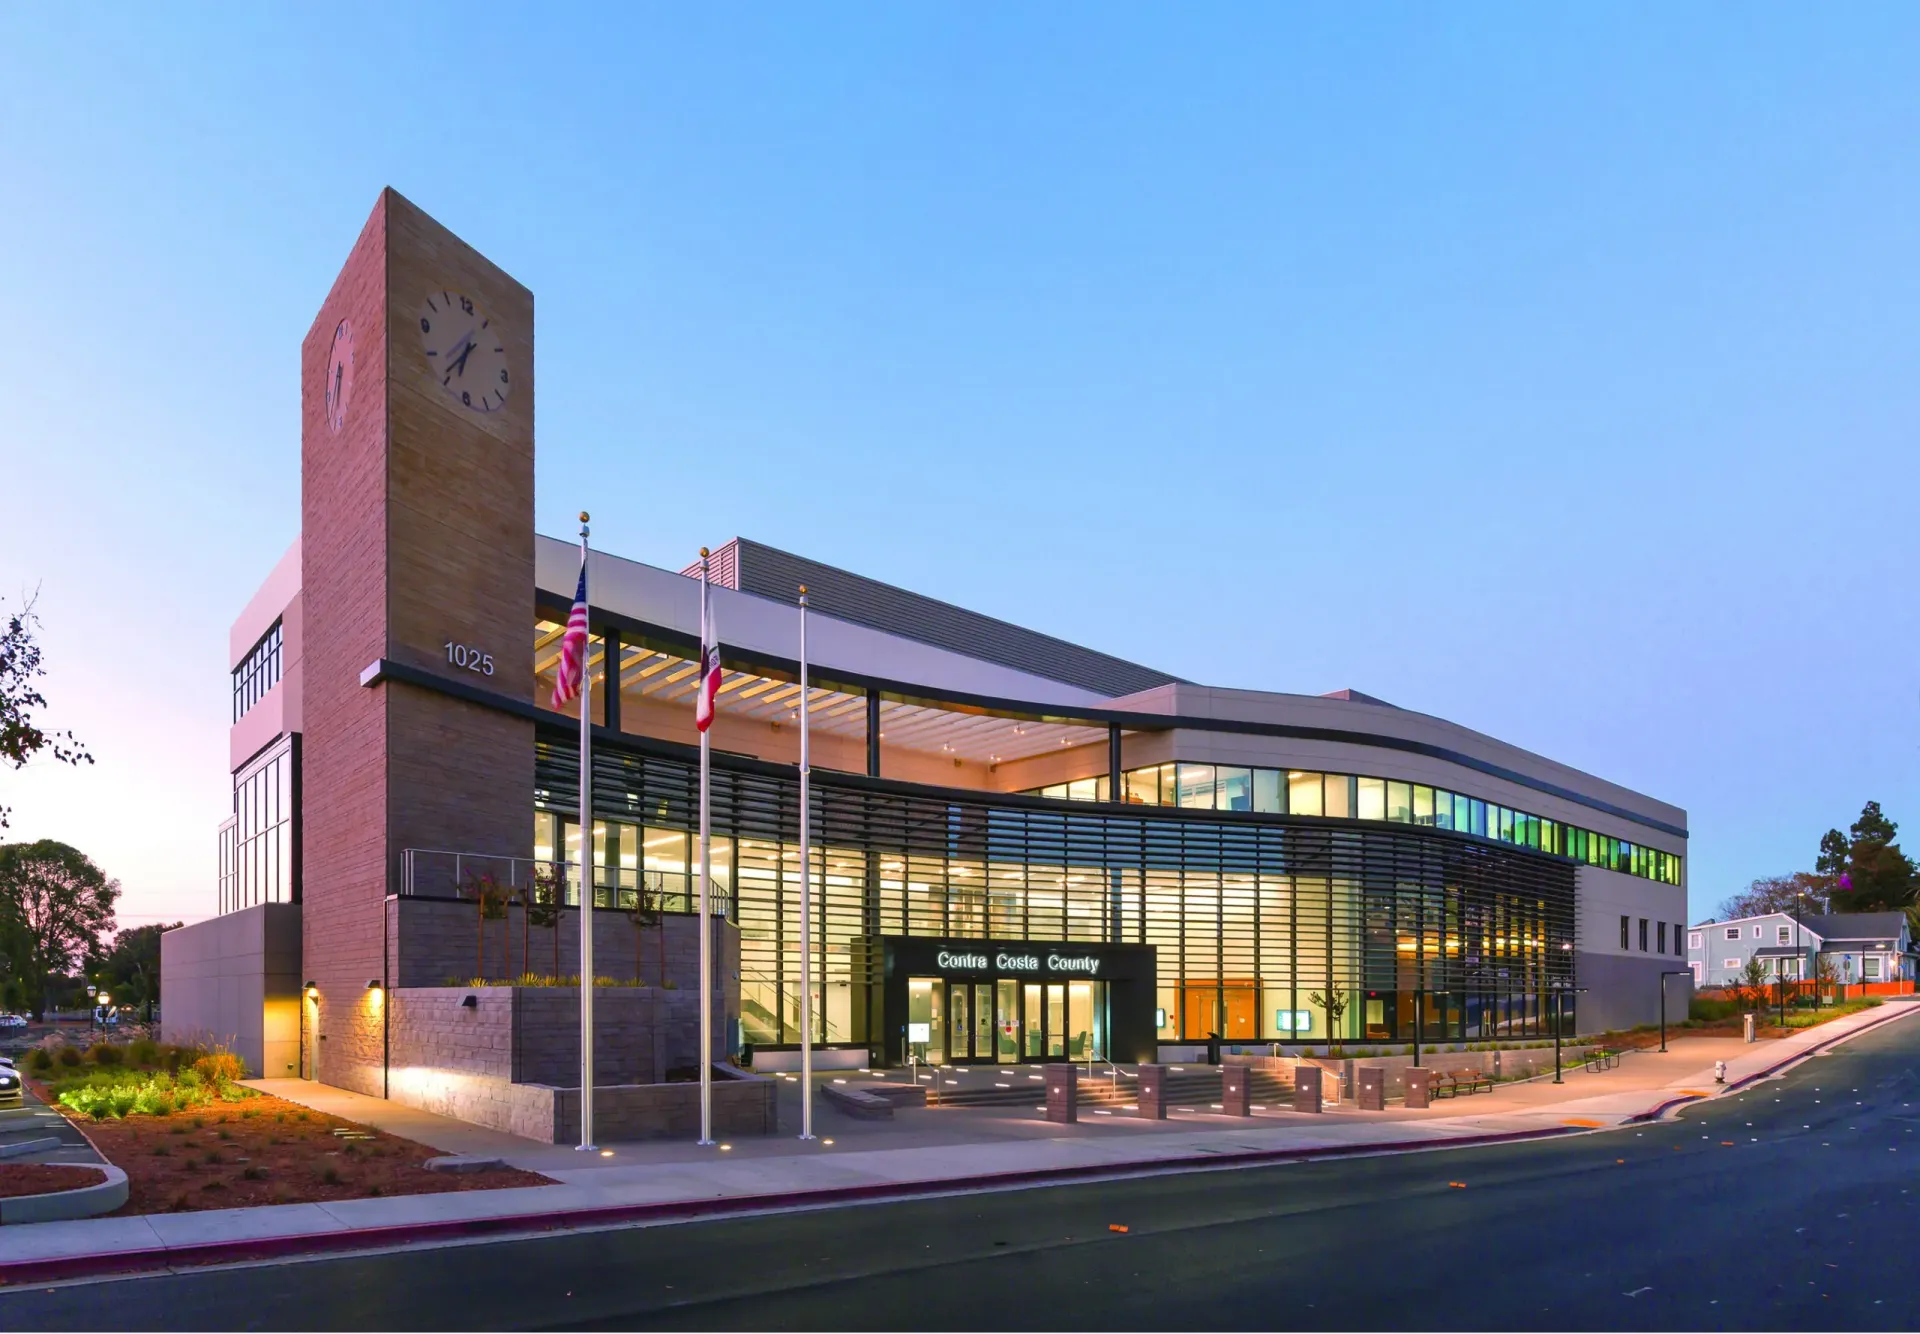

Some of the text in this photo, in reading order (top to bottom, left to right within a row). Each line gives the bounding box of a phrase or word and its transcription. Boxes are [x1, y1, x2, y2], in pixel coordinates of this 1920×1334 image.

[460, 296, 474, 316] 12
[501, 369, 509, 384] 3
[462, 391, 471, 407] 6
[444, 641, 494, 676] 1025
[937, 951, 1100, 974] Contra Costa County
